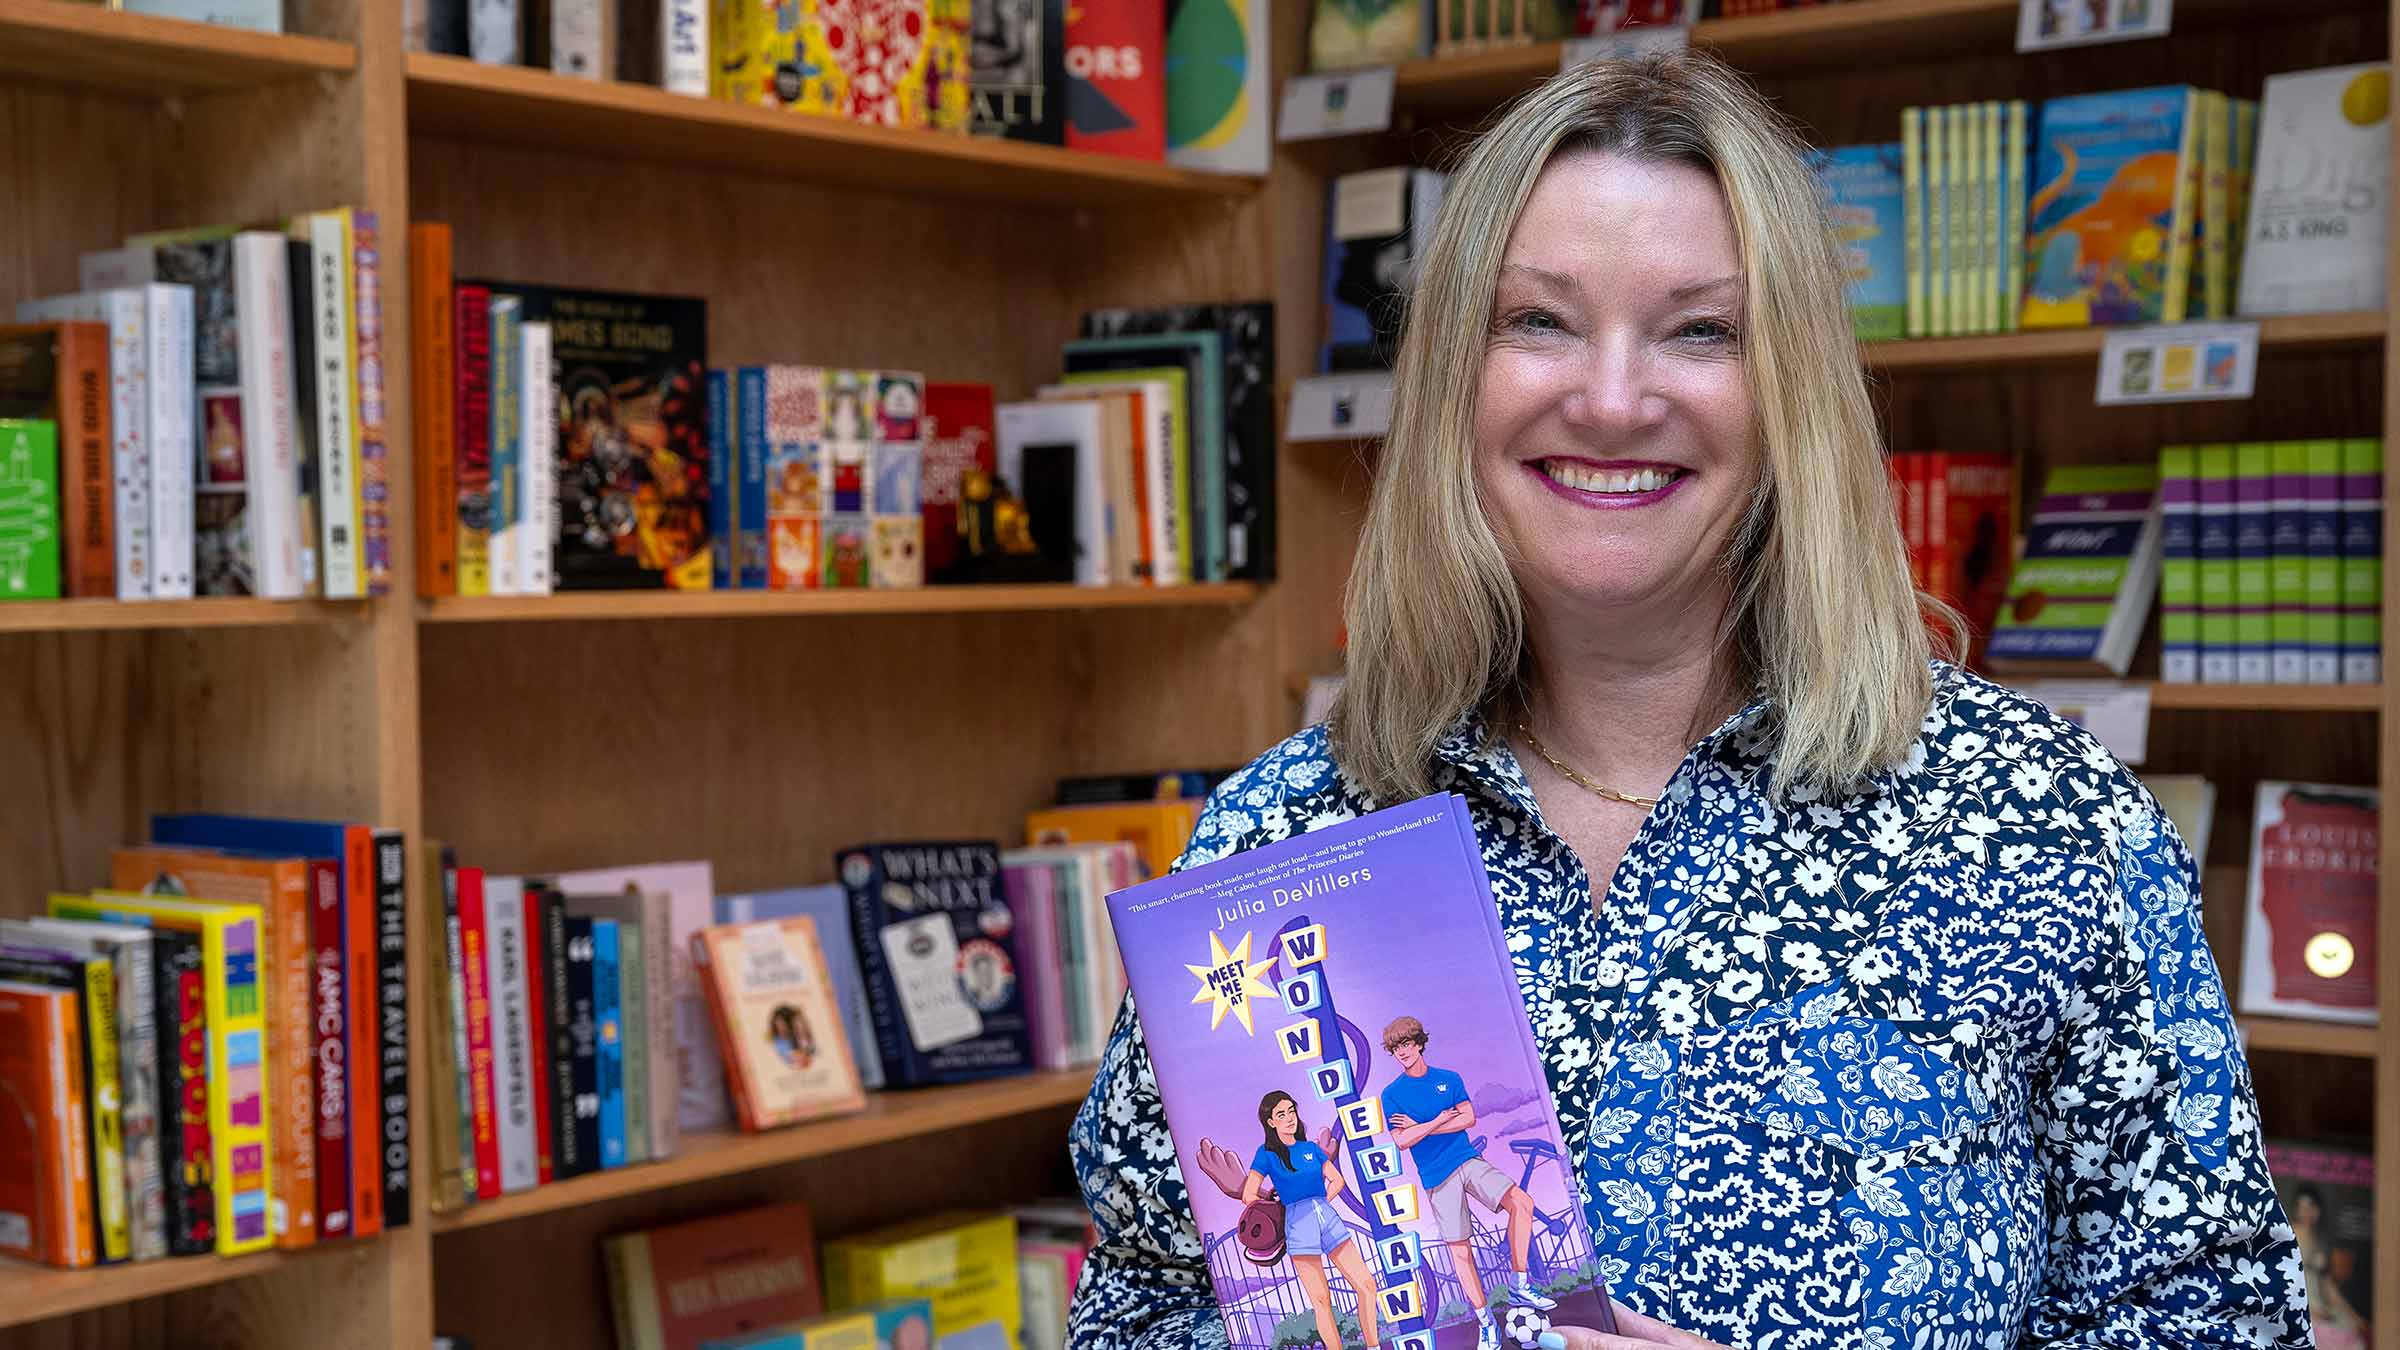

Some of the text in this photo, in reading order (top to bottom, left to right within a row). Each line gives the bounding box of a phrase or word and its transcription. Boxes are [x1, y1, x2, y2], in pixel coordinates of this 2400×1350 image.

[675, 10, 697, 54] Art
[2299, 214, 2349, 239] KING
[881, 848, 998, 881] WHAT'S
[1170, 886, 1204, 902] charming
[1204, 881, 1223, 892] book
[1224, 874, 1243, 885] made
[1256, 864, 1278, 878] laugh
[1330, 842, 1348, 854] long
[1376, 820, 1423, 838] Wonderland
[1233, 881, 1258, 895] Cabot,
[1257, 872, 1283, 887] author
[1292, 866, 1307, 876] The
[1307, 857, 1339, 872] Princess
[1338, 850, 1365, 863] Diaries
[381, 891, 401, 949] THE
[912, 876, 993, 910] NEXT
[1216, 868, 1373, 931] Julia DeVillers
[223, 917, 259, 1018] THE
[1206, 959, 1245, 991] MEET
[1220, 978, 1242, 997] ME
[287, 956, 308, 1068] TENNIS
[381, 967, 406, 1081] TRAVEL
[501, 927, 529, 1129] KARL LAGERFELD
[1230, 993, 1243, 1006] AT
[318, 966, 345, 1121] AMC CARS
[291, 1075, 314, 1181] COURT
[385, 1095, 409, 1191] BOOK
